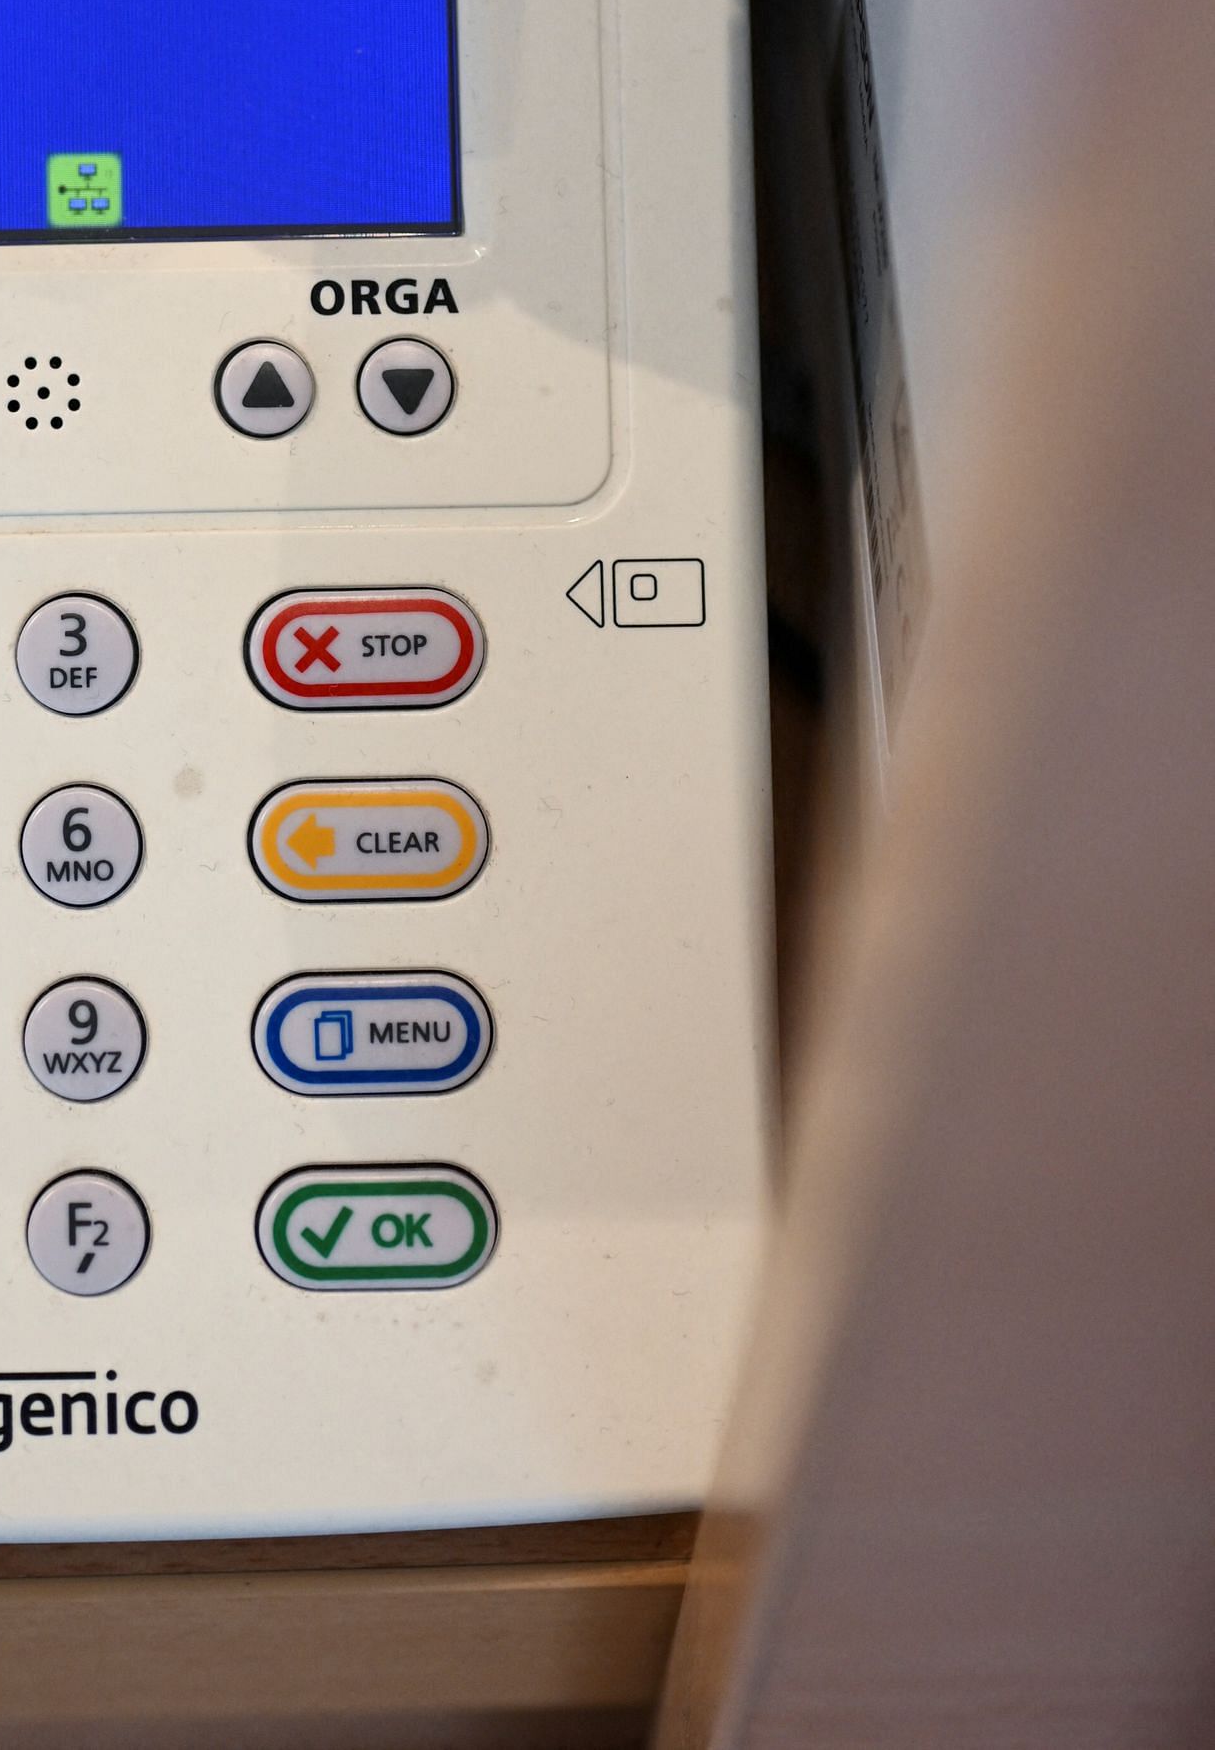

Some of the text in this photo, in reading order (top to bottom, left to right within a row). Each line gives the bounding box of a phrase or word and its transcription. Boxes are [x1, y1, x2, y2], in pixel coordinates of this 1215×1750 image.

[309, 277, 460, 317] ORGA
[59, 612, 88, 657] 3
[361, 633, 428, 659] STOP
[49, 666, 98, 689] DEF
[62, 807, 92, 853] 6
[356, 831, 440, 855] CLEAR
[46, 859, 115, 883] MNO
[68, 999, 99, 1046] 9
[369, 1020, 452, 1045] MENU
[42, 1050, 123, 1076] WXYZ
[370, 1212, 434, 1249] OK
